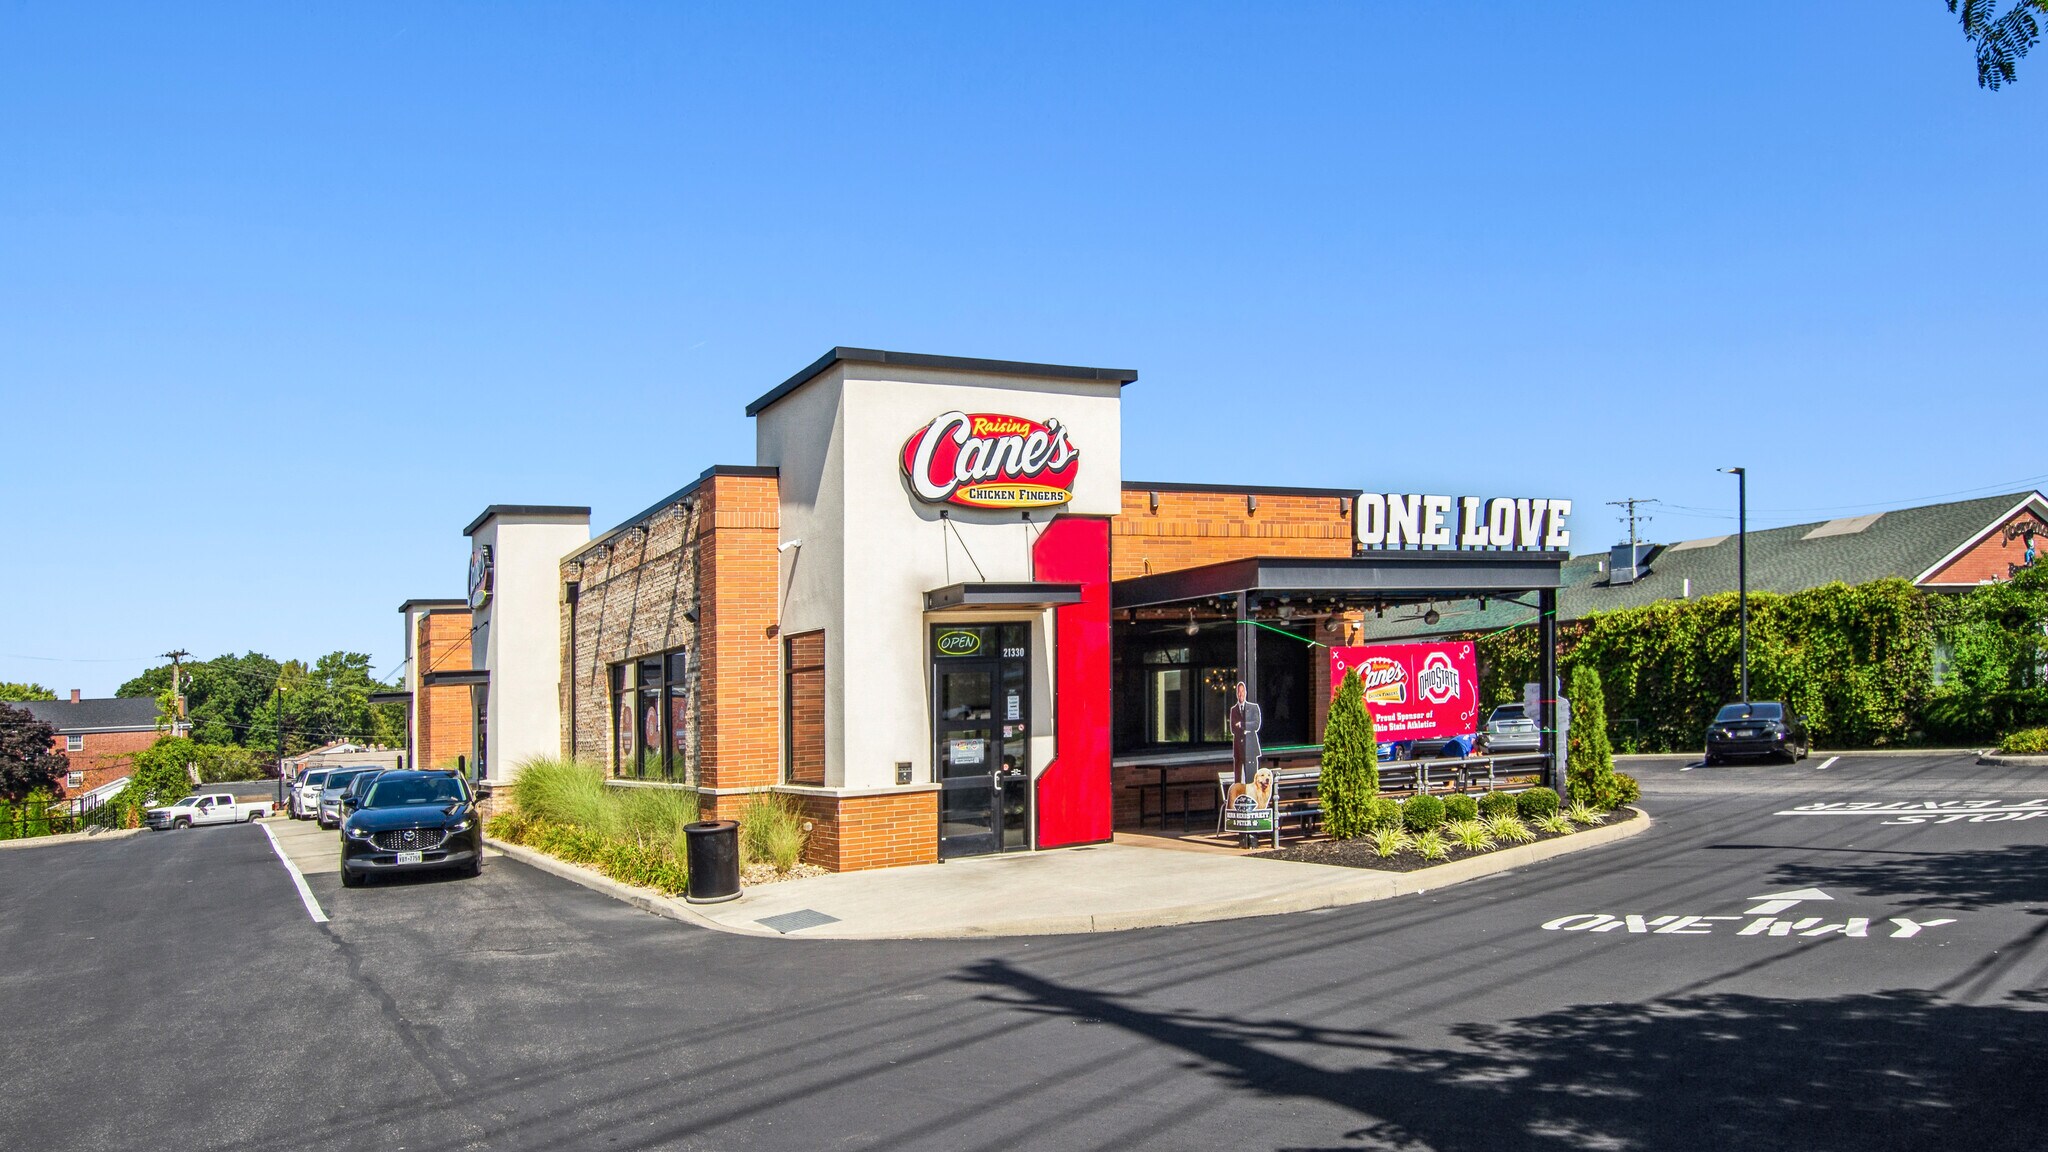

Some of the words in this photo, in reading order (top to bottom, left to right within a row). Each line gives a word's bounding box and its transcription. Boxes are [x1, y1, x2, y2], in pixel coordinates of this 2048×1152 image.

[972, 417, 1030, 437] Raising
[912, 410, 1080, 499] Cane's
[969, 488, 1015, 500] CHICKEN
[1019, 489, 1064, 501] FINGERS
[1357, 493, 1452, 545] ONE
[1461, 496, 1572, 547] LOVE
[941, 636, 975, 649] OPEN
[1003, 648, 1025, 657] 21330
[1420, 670, 1436, 698] OHIO
[1436, 667, 1458, 696] STATE
[1376, 713, 1396, 722] Proud
[1397, 712, 1425, 722] Sponsor
[1426, 710, 1433, 718] of
[1389, 722, 1406, 731] State
[1407, 720, 1436, 729] Athletics
[1541, 914, 1743, 934] ONE
[1736, 917, 1958, 937] WAY
